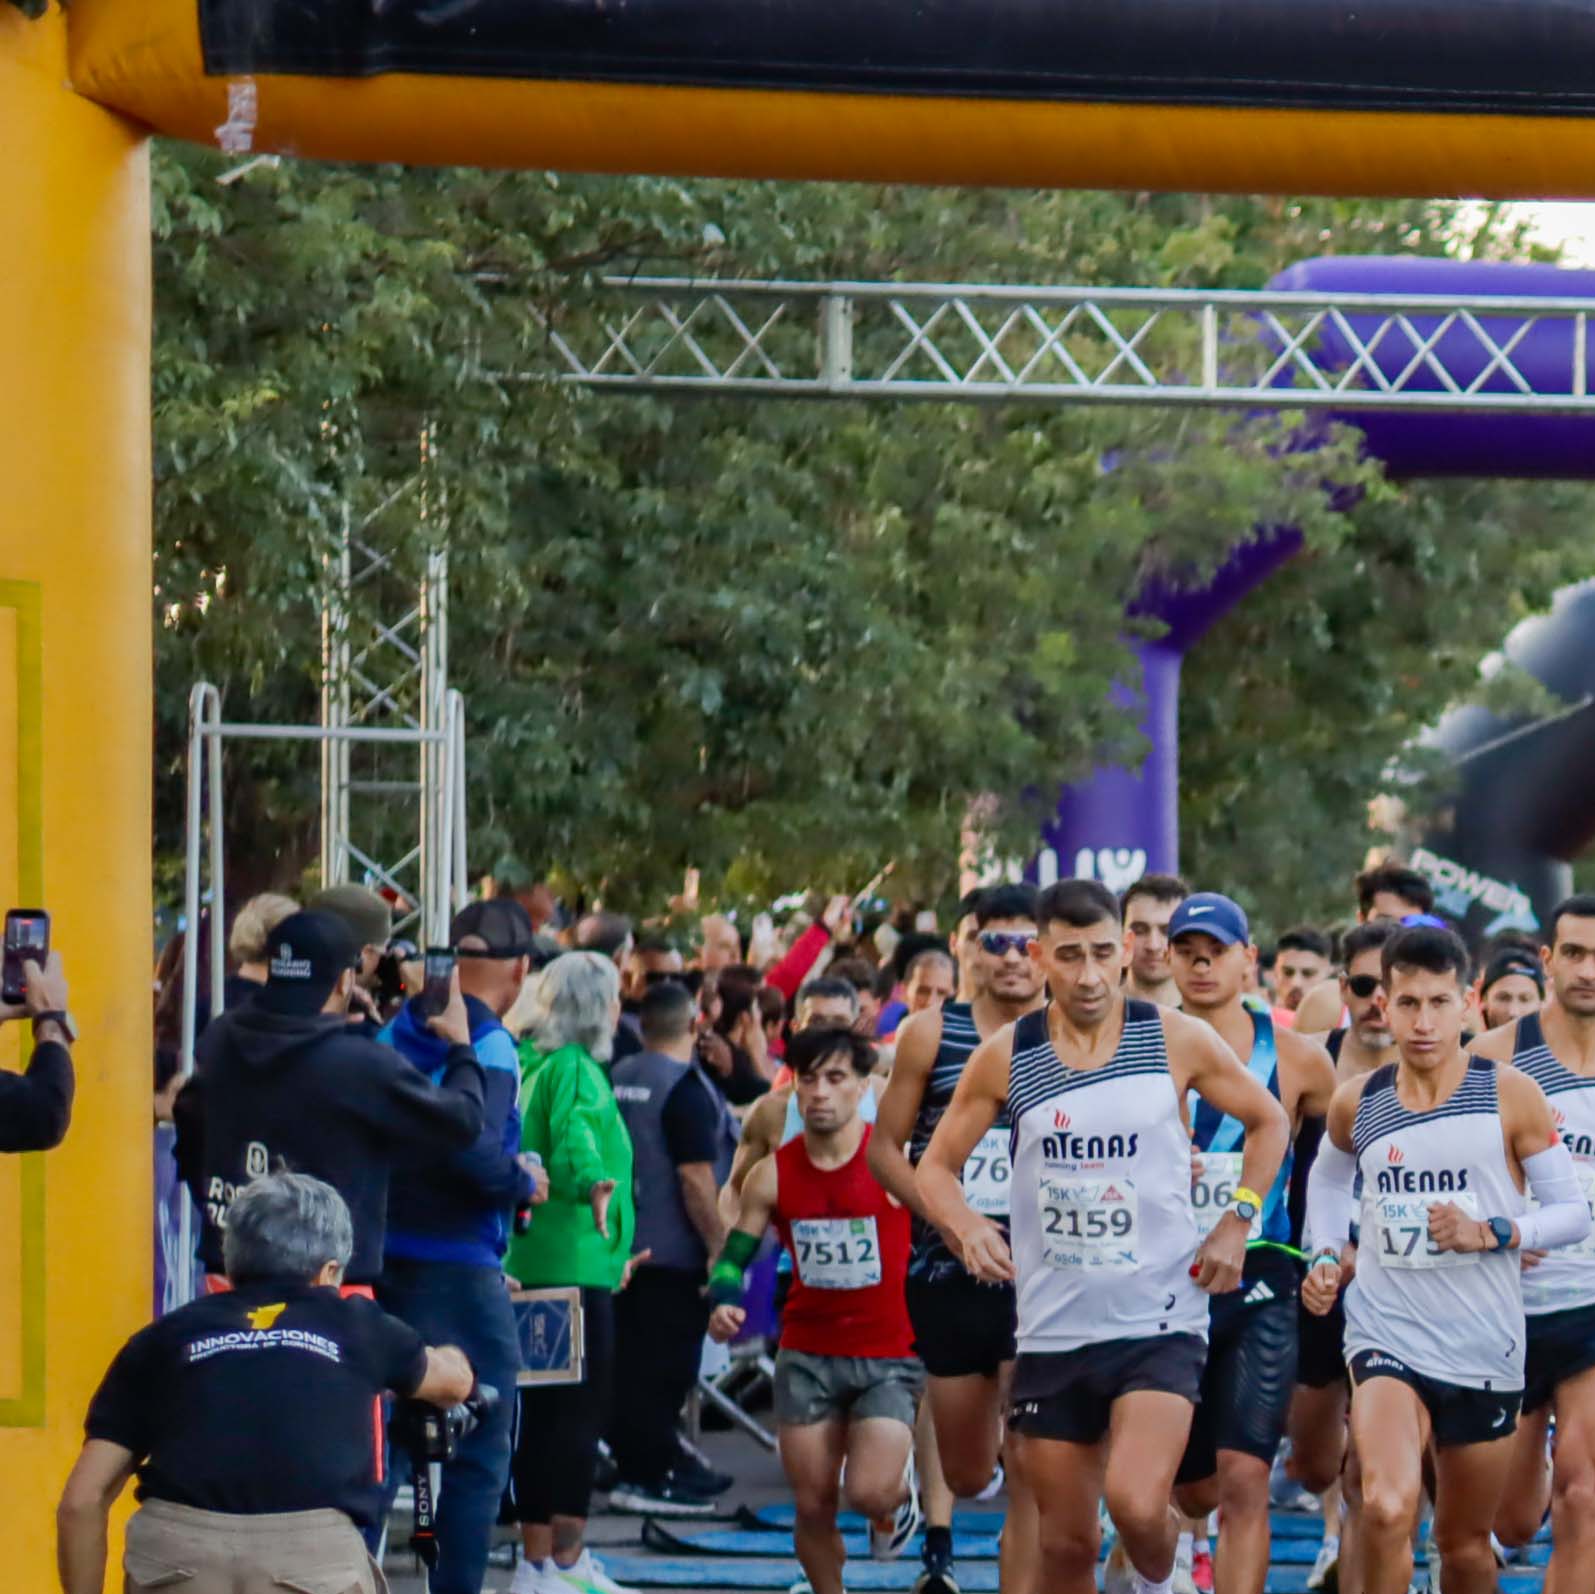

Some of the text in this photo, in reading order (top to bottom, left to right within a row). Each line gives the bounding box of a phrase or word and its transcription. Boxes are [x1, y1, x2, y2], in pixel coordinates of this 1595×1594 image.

[1042, 1131, 1139, 1161] ATENAS
[1377, 1166, 1468, 1193] ATENAS
[1044, 1207, 1133, 1238] 2159
[1383, 1204, 1408, 1218] 15K
[796, 1238, 876, 1266] 7512
[190, 1328, 340, 1356] INNOVACIONES
